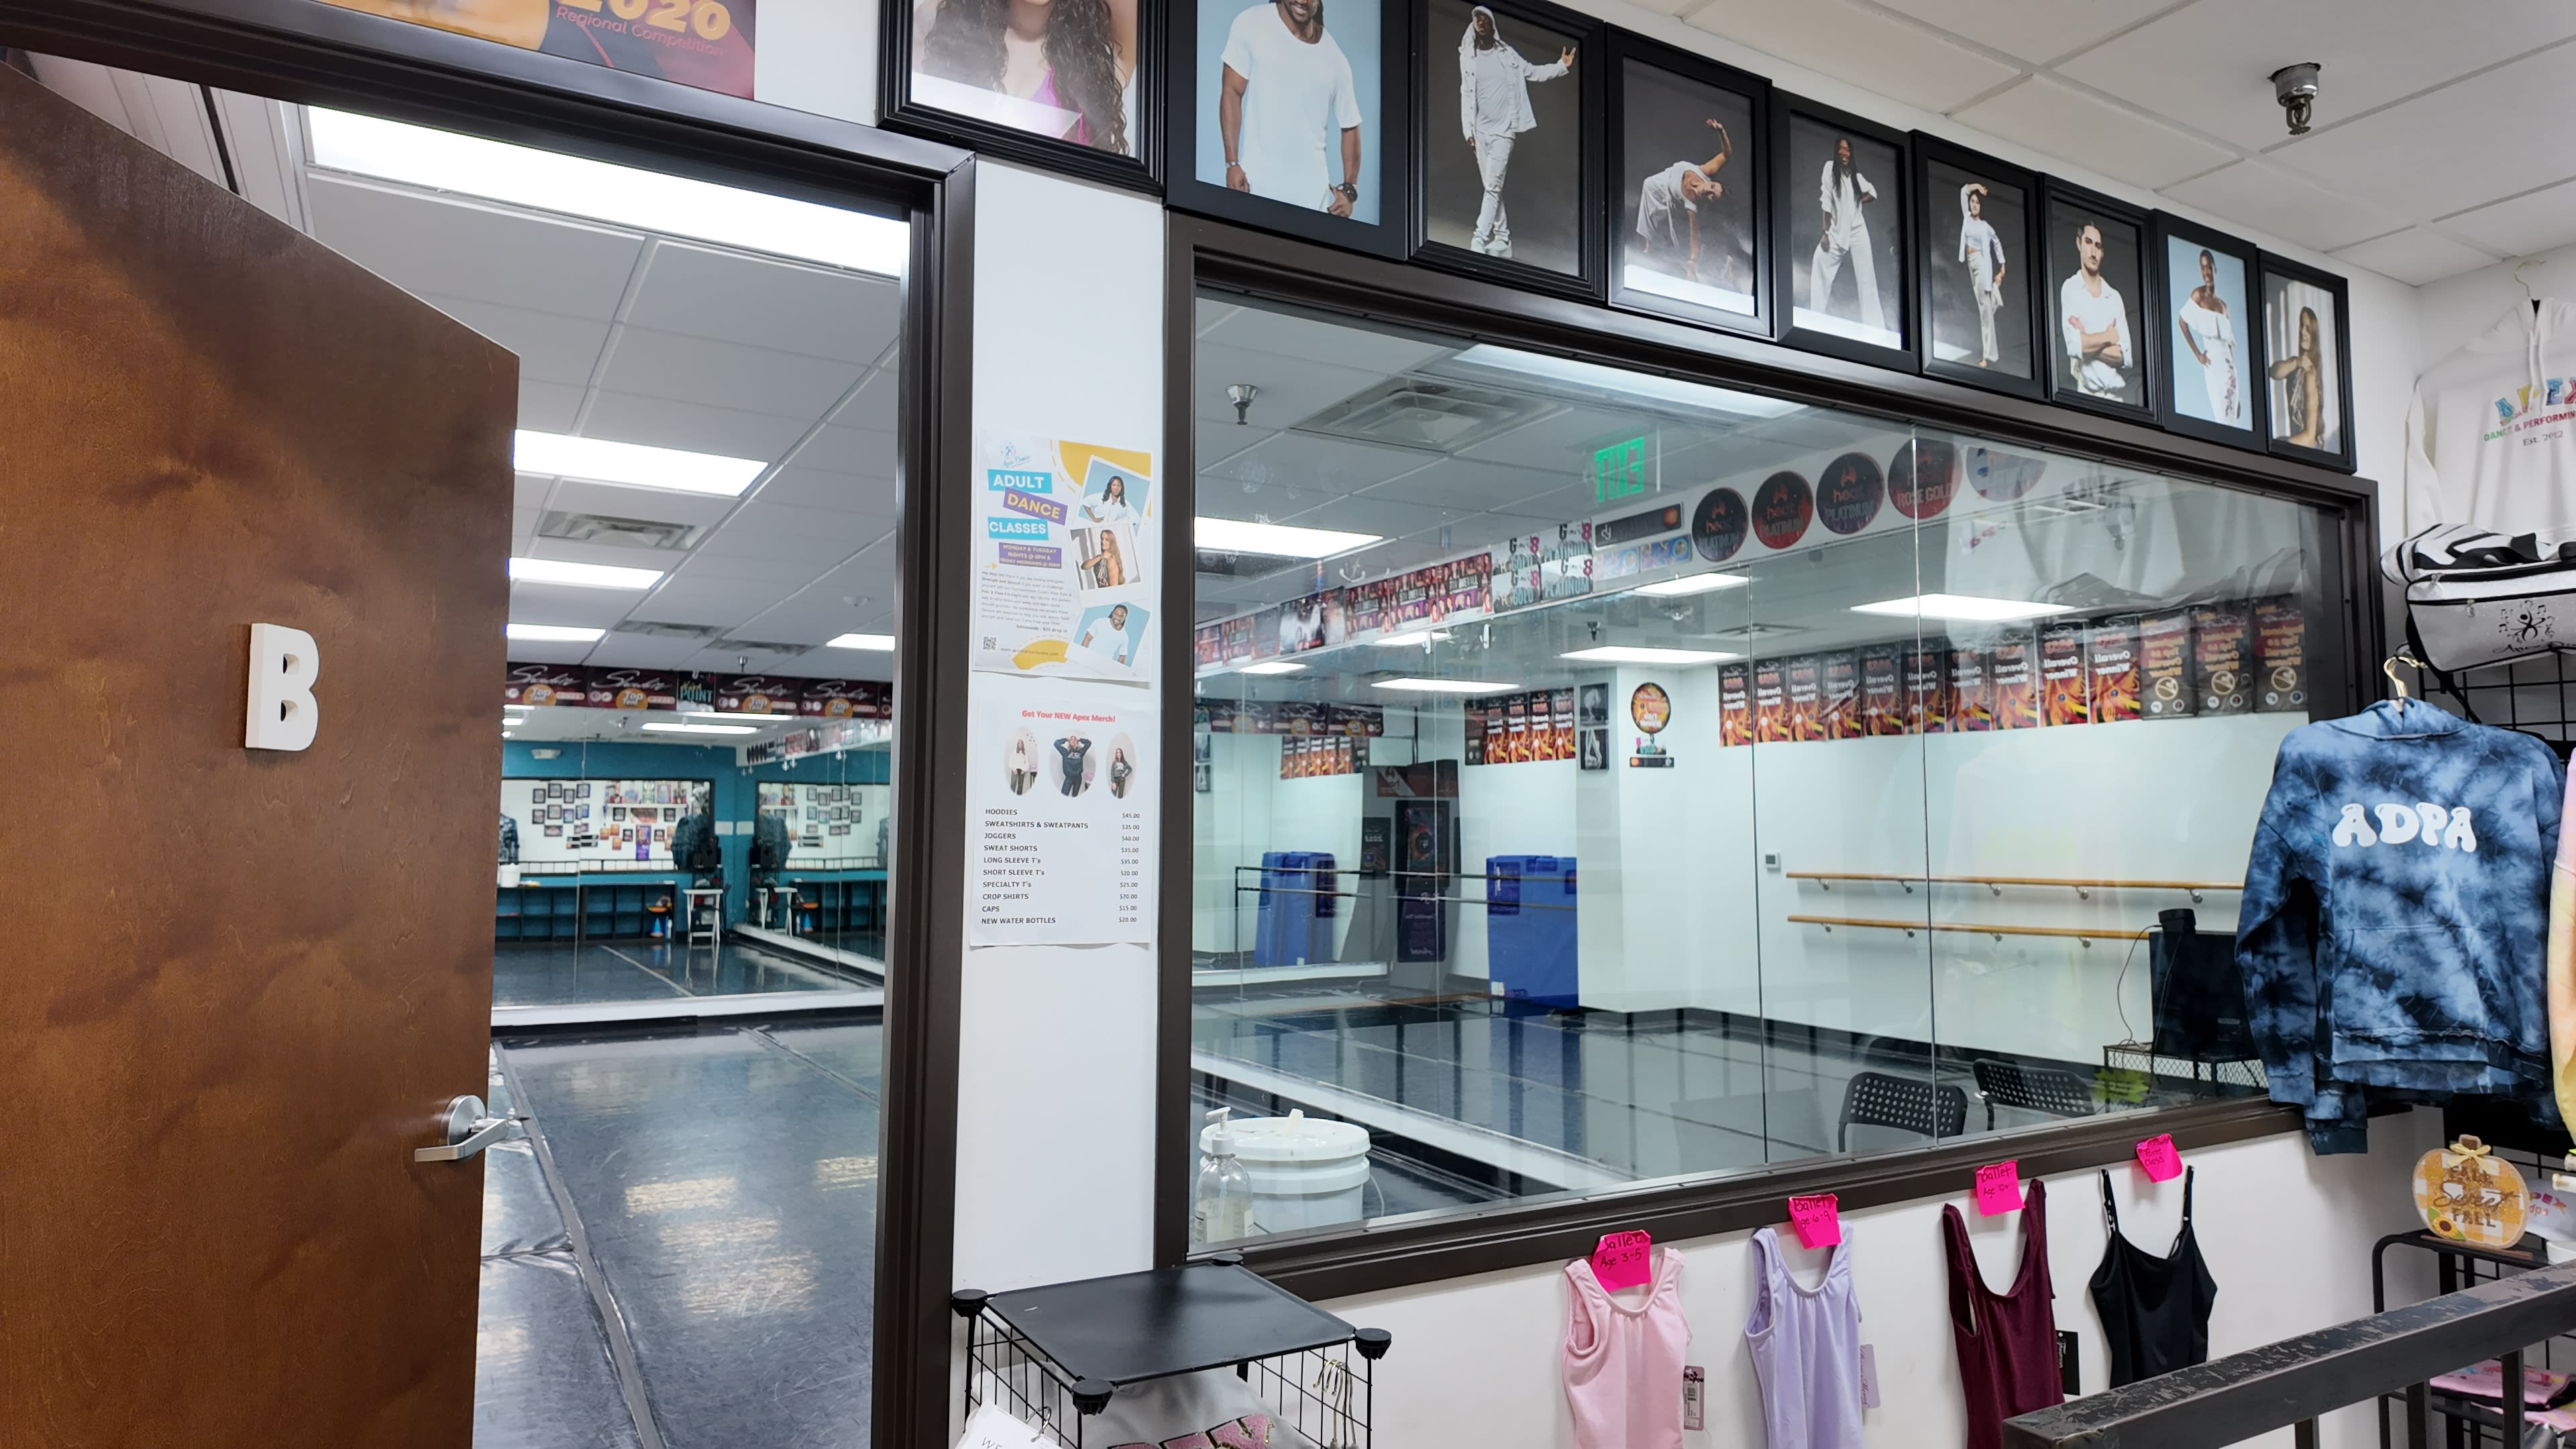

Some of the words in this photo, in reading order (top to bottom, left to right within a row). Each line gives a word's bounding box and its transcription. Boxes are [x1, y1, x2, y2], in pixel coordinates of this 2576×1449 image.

[555, 6, 627, 34] Regional
[631, 24, 724, 57] Competition
[2514, 423, 2521, 432] &
[994, 474, 1044, 488] ADULT
[1896, 486, 1923, 508] ROSE
[1925, 482, 1953, 503] GOLD
[1008, 493, 1061, 519] DANCE
[1825, 502, 1874, 522] PLATINUM
[989, 521, 1046, 534] CLASSES
[1761, 518, 1805, 537] PLATINUM
[1544, 541, 1589, 561] PLATINUM
[1513, 588, 1534, 605] GOLD
[1544, 577, 1589, 598] PLATINUM
[246, 623, 319, 751] B
[680, 689, 712, 702] POINT
[1073, 714, 1089, 722] Apex
[2332, 802, 2477, 853] ADPA
[1984, 1187, 1995, 1199] Age
[2433, 1181, 2521, 1208] Sweet
[1794, 1197, 1826, 1212] Ballet
[1800, 1218, 1810, 1228] ge
[1813, 1210, 1831, 1222] 6-9
[2453, 1208, 2496, 1228] FALL
[1600, 1256, 1616, 1270] Age
[1621, 1248, 1642, 1262] 3-5
